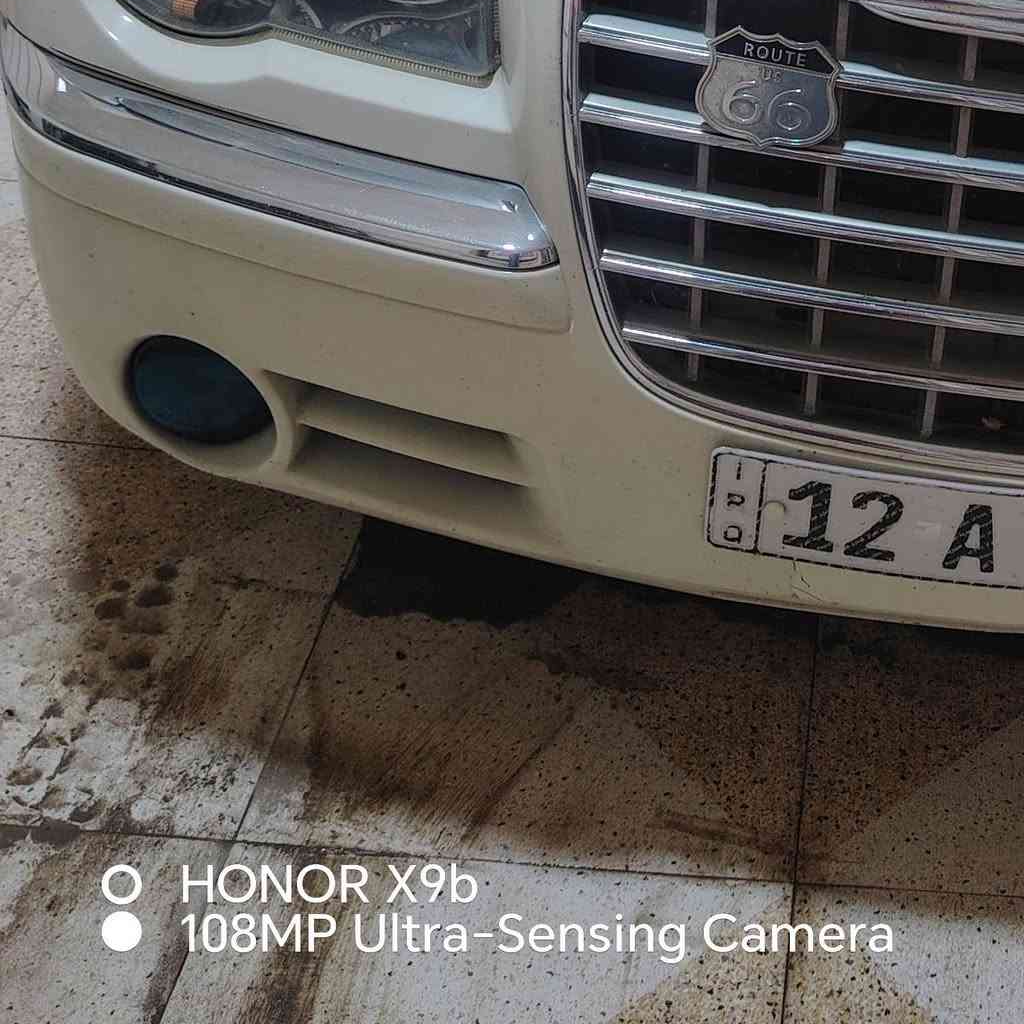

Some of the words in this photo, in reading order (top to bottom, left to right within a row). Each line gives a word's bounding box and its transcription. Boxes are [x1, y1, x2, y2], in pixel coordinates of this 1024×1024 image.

[743, 42, 808, 66] ROUTE
[723, 80, 812, 131] 66
[782, 481, 904, 562] 12
[942, 504, 994, 573] A
